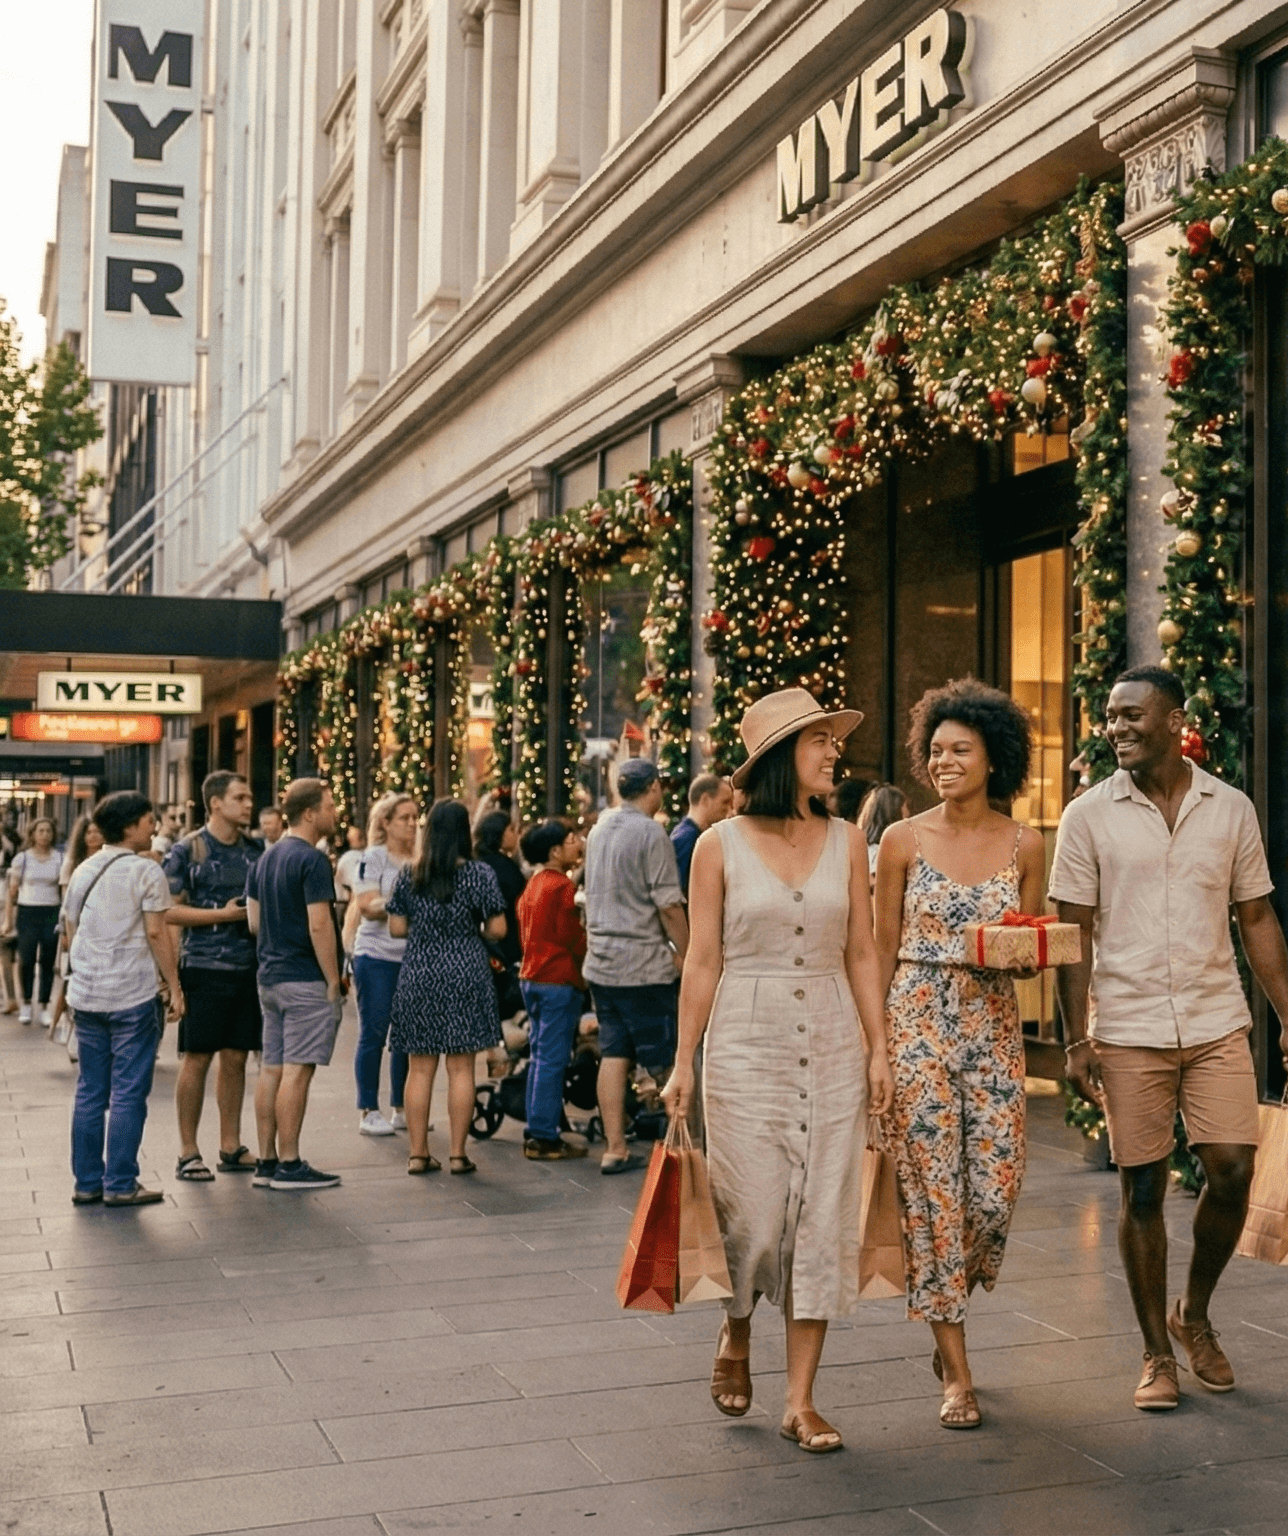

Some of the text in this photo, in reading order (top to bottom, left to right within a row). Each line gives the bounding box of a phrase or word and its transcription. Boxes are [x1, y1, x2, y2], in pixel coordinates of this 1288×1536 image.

[103, 23, 194, 318] MYER
[777, 8, 967, 224] MYER
[56, 681, 185, 702] MYER
